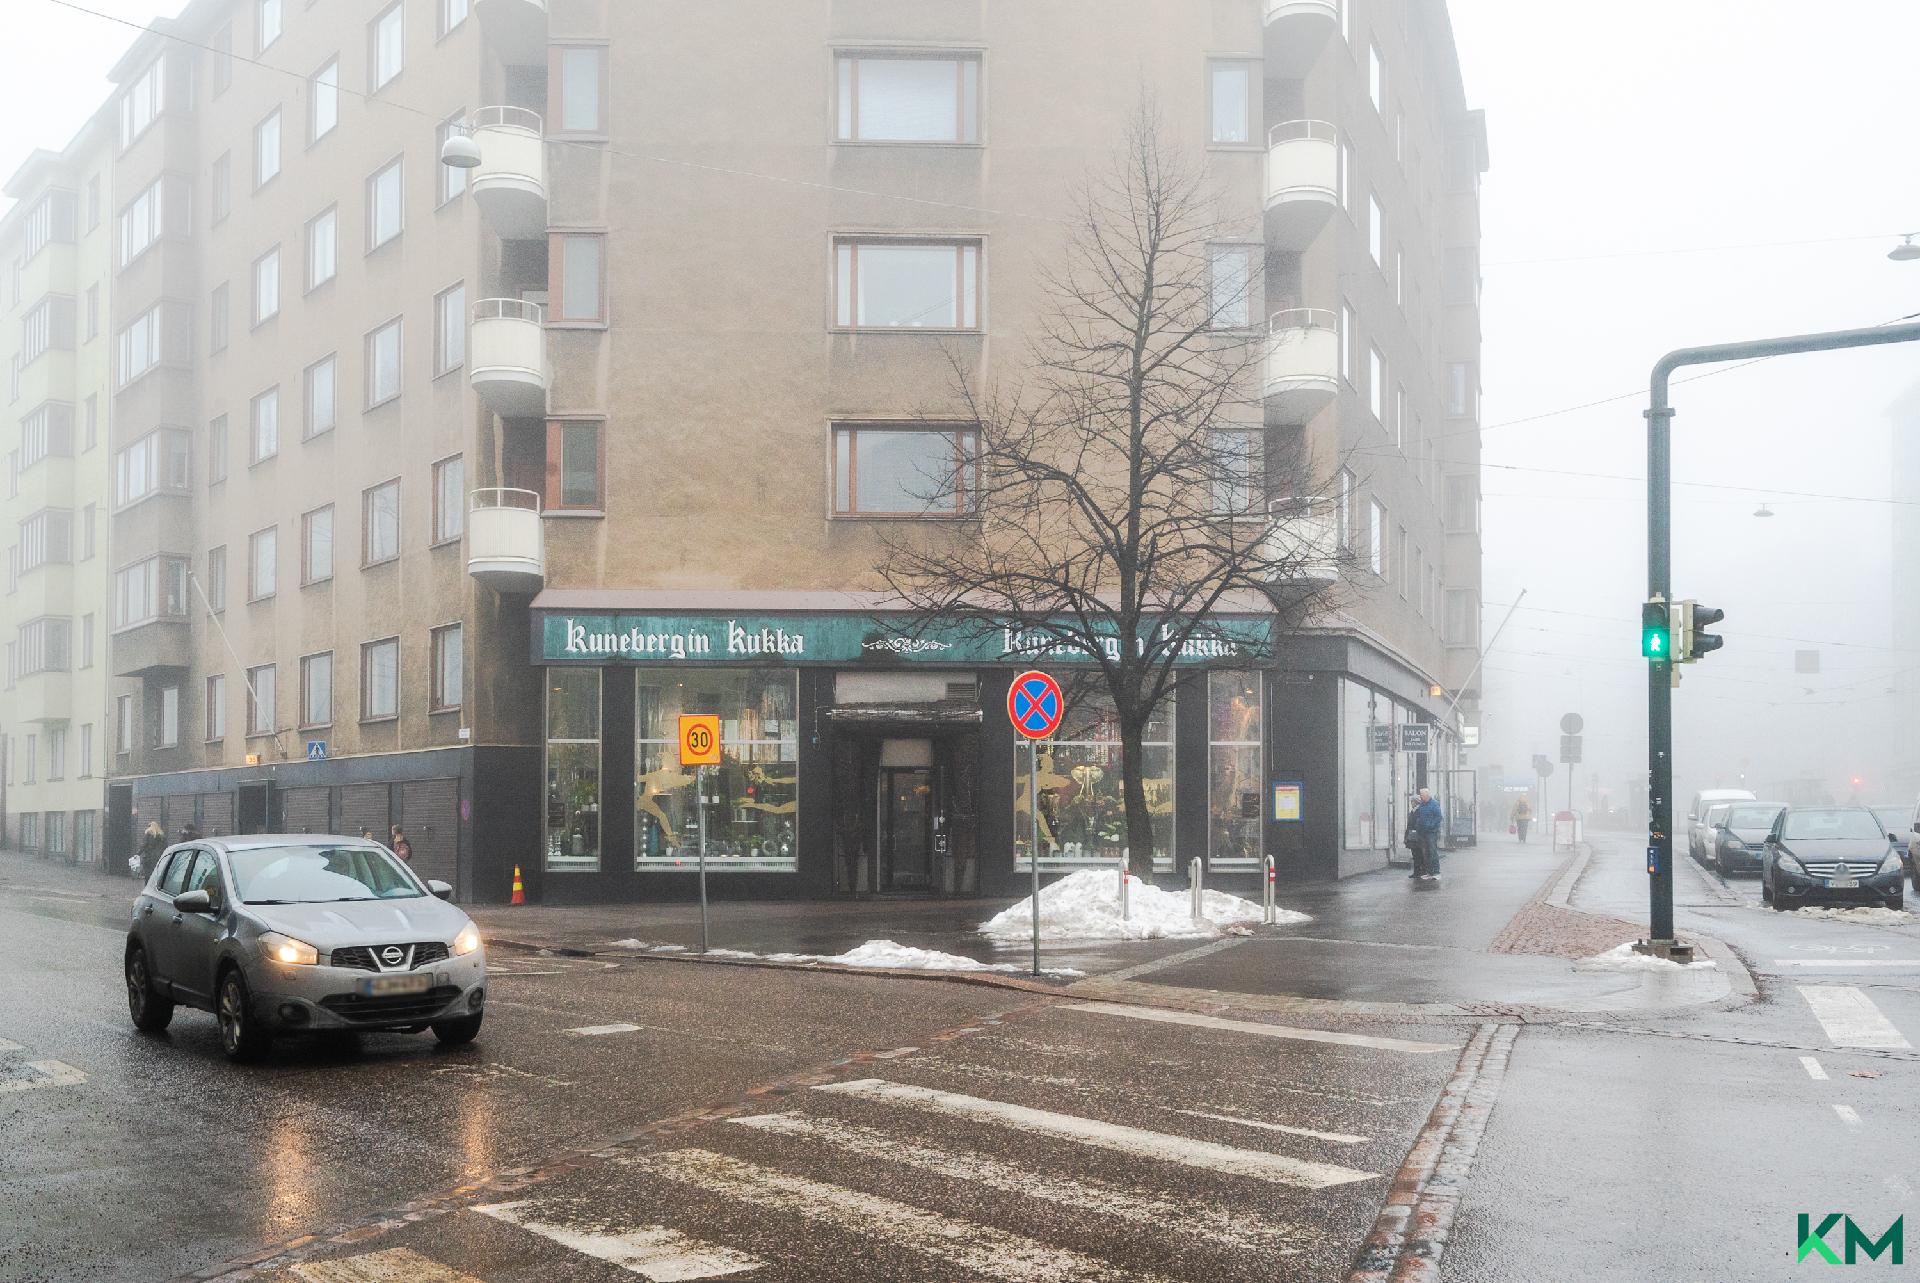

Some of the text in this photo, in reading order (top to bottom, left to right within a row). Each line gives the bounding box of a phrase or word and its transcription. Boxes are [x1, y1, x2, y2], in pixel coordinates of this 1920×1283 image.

[564, 617, 805, 659] Runebergin Kukka
[691, 731, 709, 748] 30
